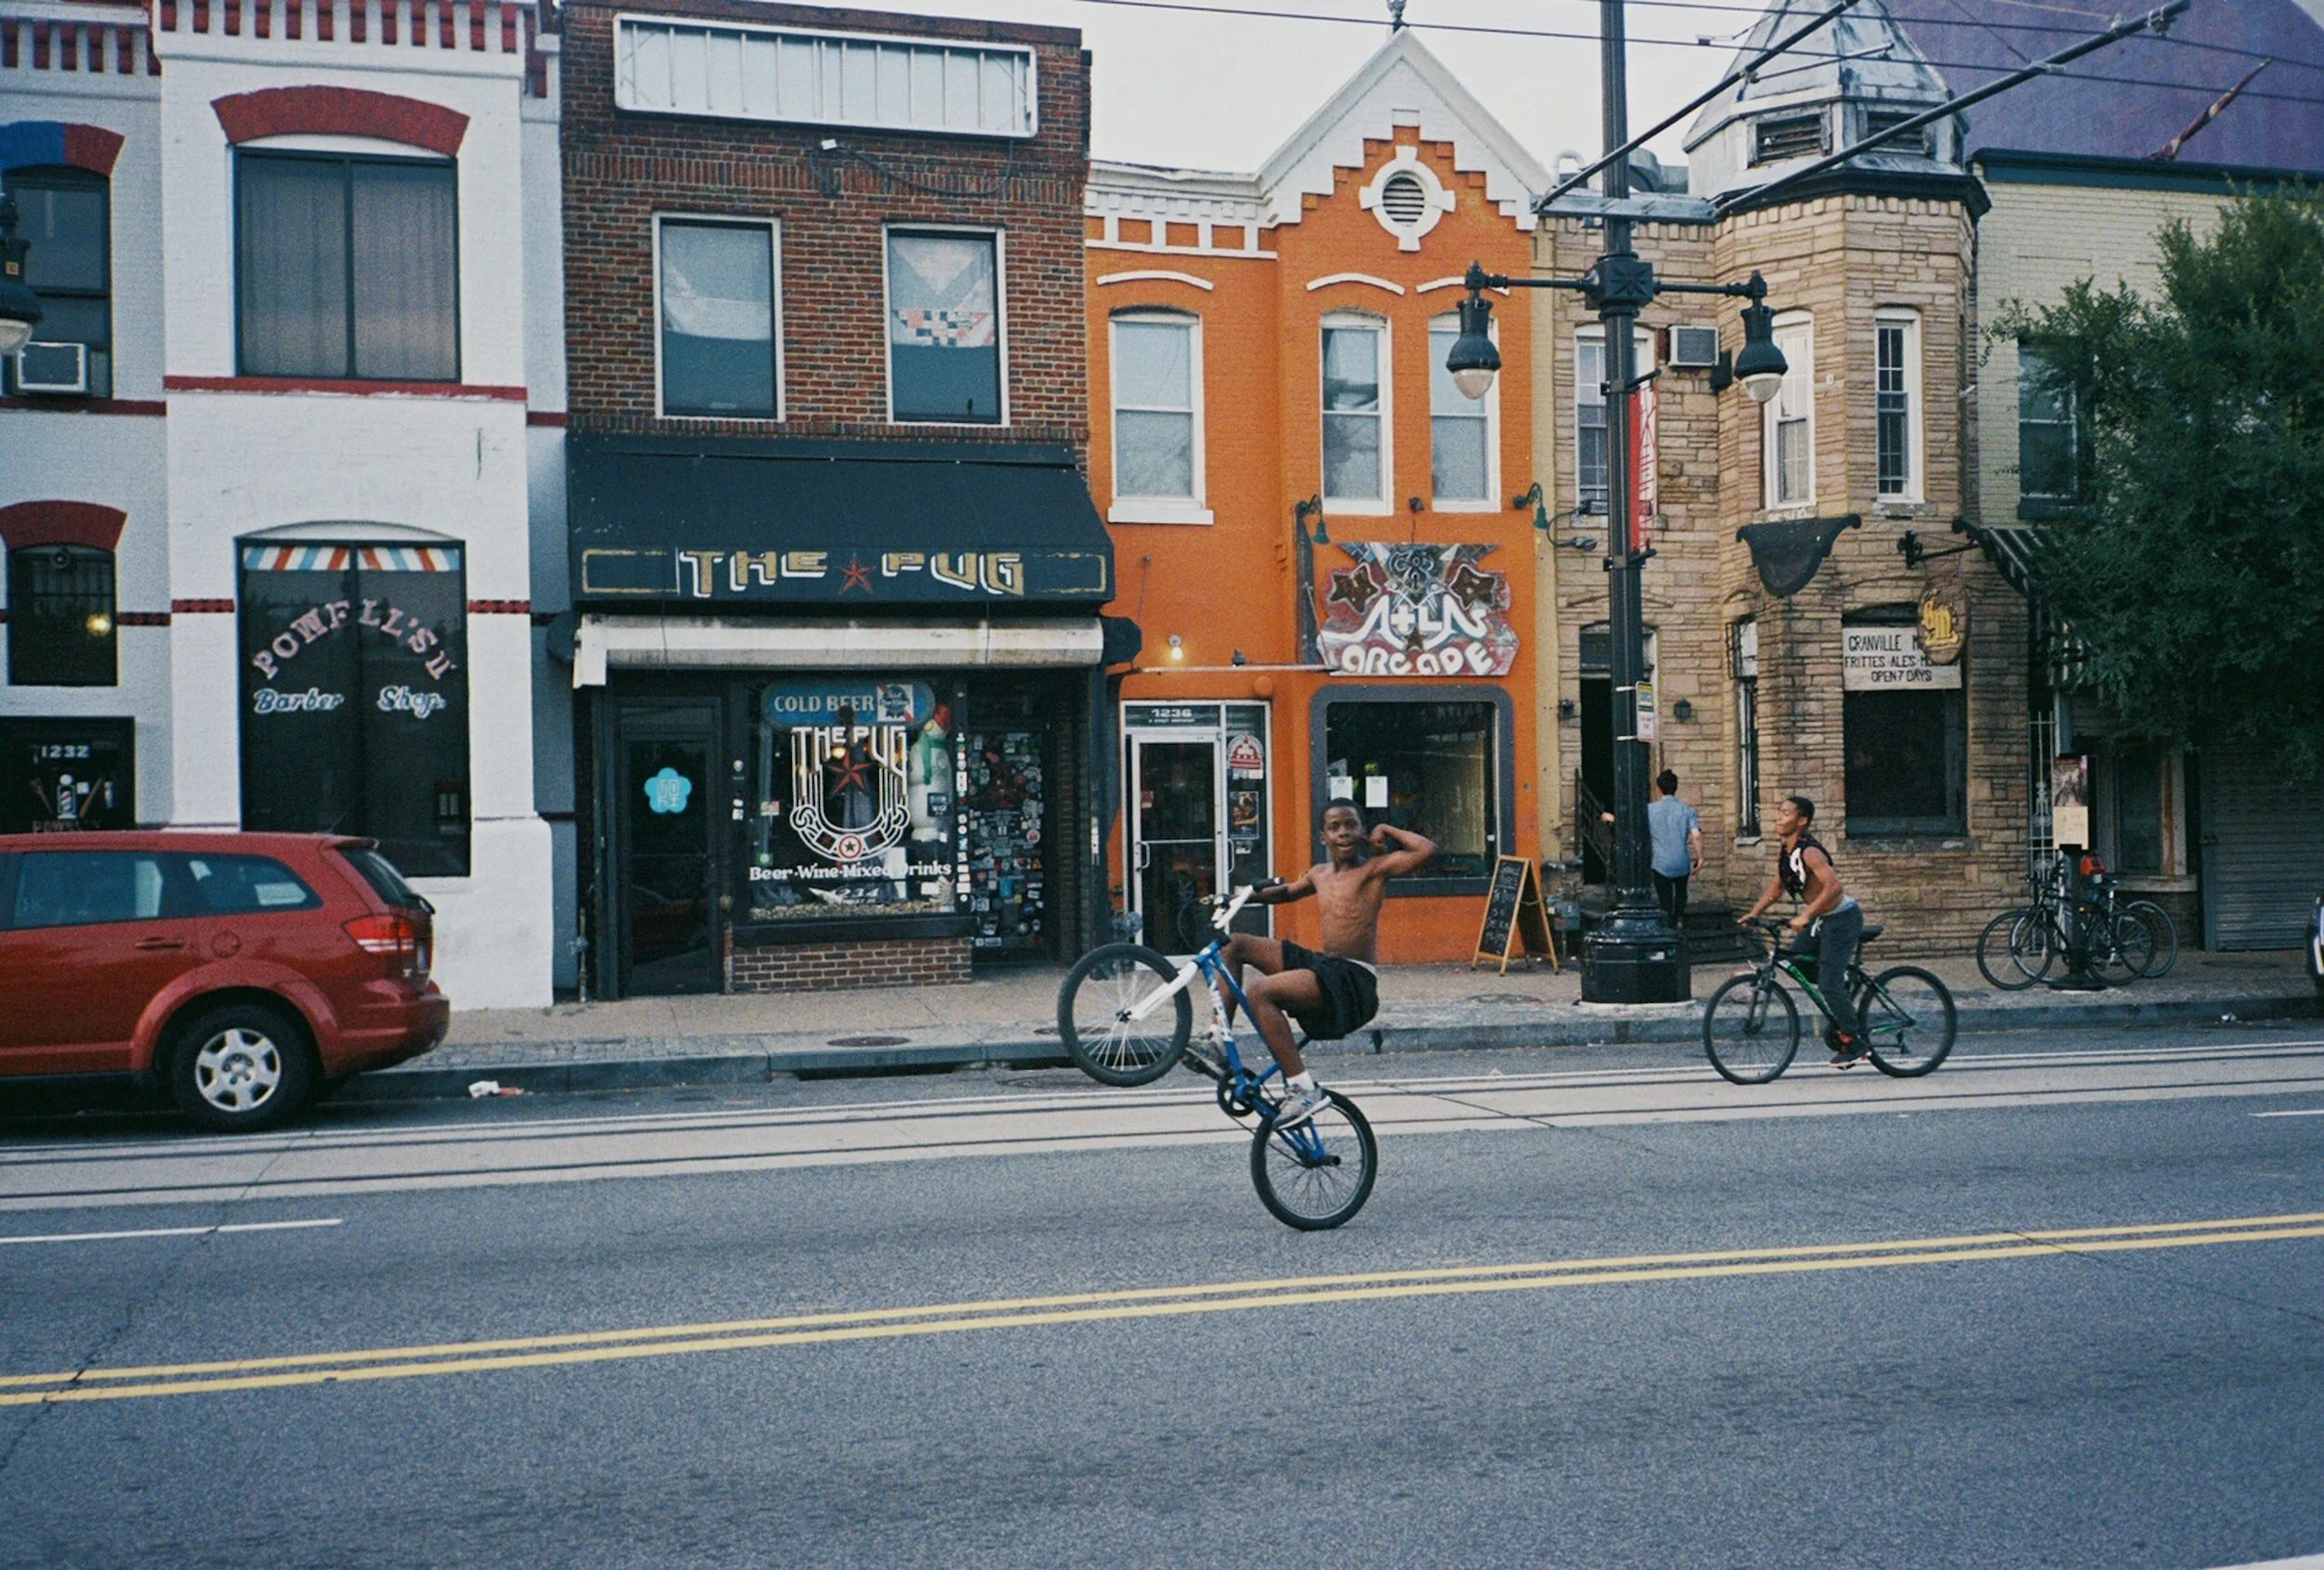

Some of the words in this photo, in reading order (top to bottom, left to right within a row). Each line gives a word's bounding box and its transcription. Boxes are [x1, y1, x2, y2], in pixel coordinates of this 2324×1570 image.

[679, 549, 829, 599] THE
[880, 551, 1024, 597] PUG
[1848, 634, 1902, 652] GRANVILLE
[1890, 654, 1916, 667] ALES
[1870, 670, 1896, 683] OPEN
[1906, 669, 1933, 682] DAYS
[253, 687, 344, 714] Barber
[773, 695, 821, 713] COLD
[826, 695, 875, 713] BEER
[1151, 708, 1193, 718] 1236
[41, 745, 90, 759] 1232
